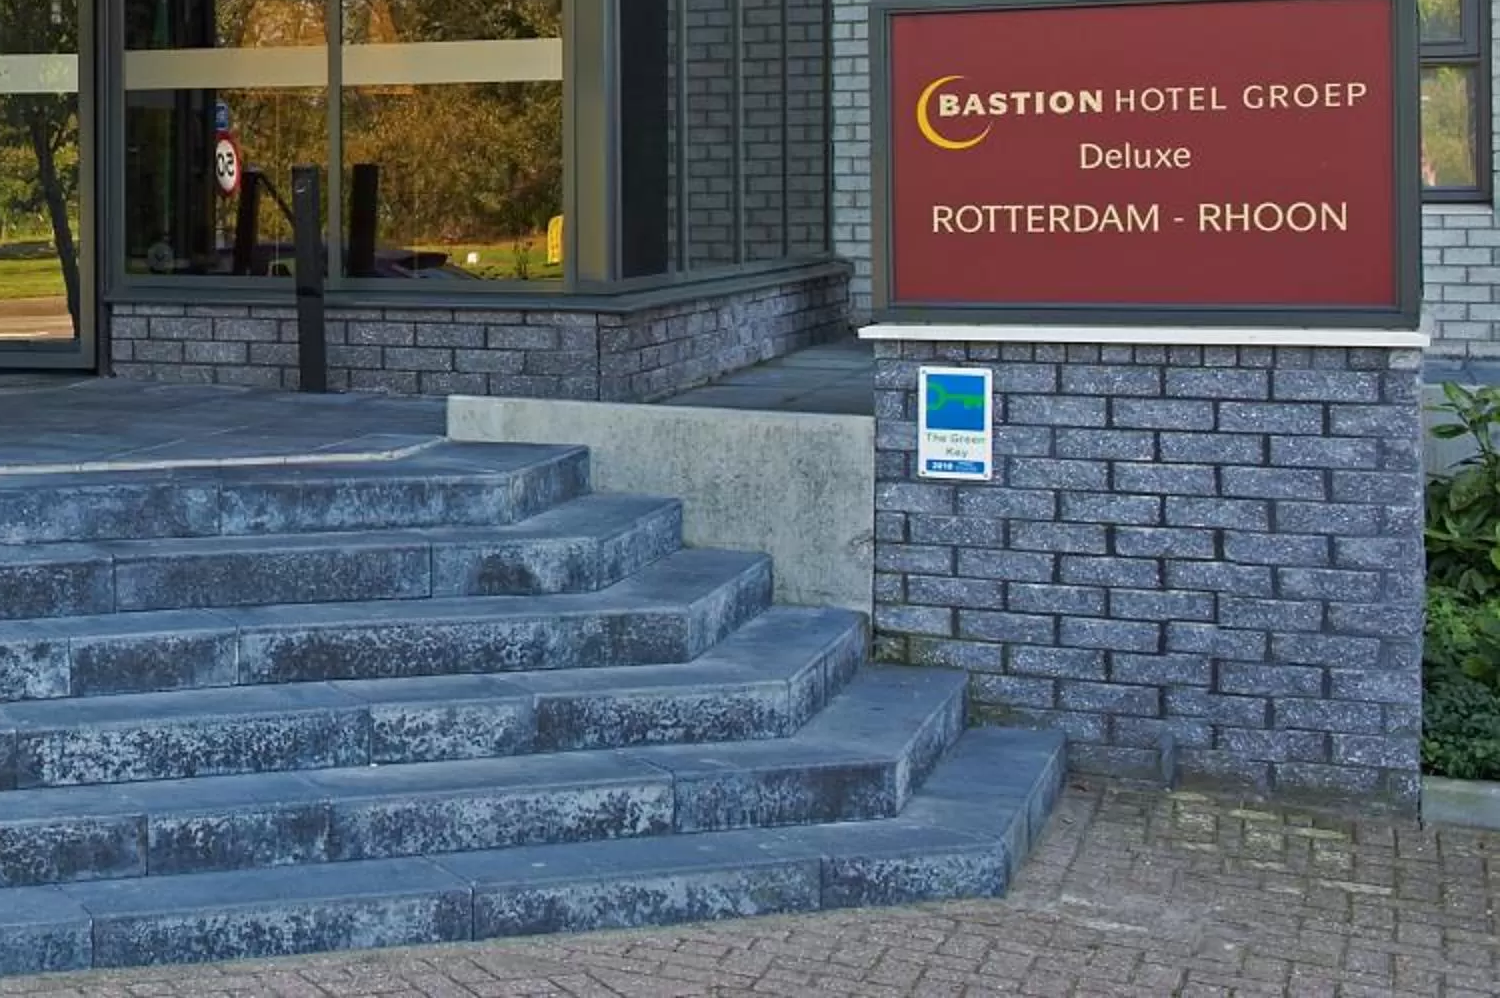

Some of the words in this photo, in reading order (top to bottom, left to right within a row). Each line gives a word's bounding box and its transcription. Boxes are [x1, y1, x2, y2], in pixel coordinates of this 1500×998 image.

[938, 89, 1104, 118] BASTION
[1114, 85, 1228, 113] HOTEL
[1242, 81, 1368, 109] GROEP
[1079, 141, 1192, 170] Deluxe
[931, 203, 1161, 234] ROTTERDAM
[1198, 201, 1349, 233] RHOON
